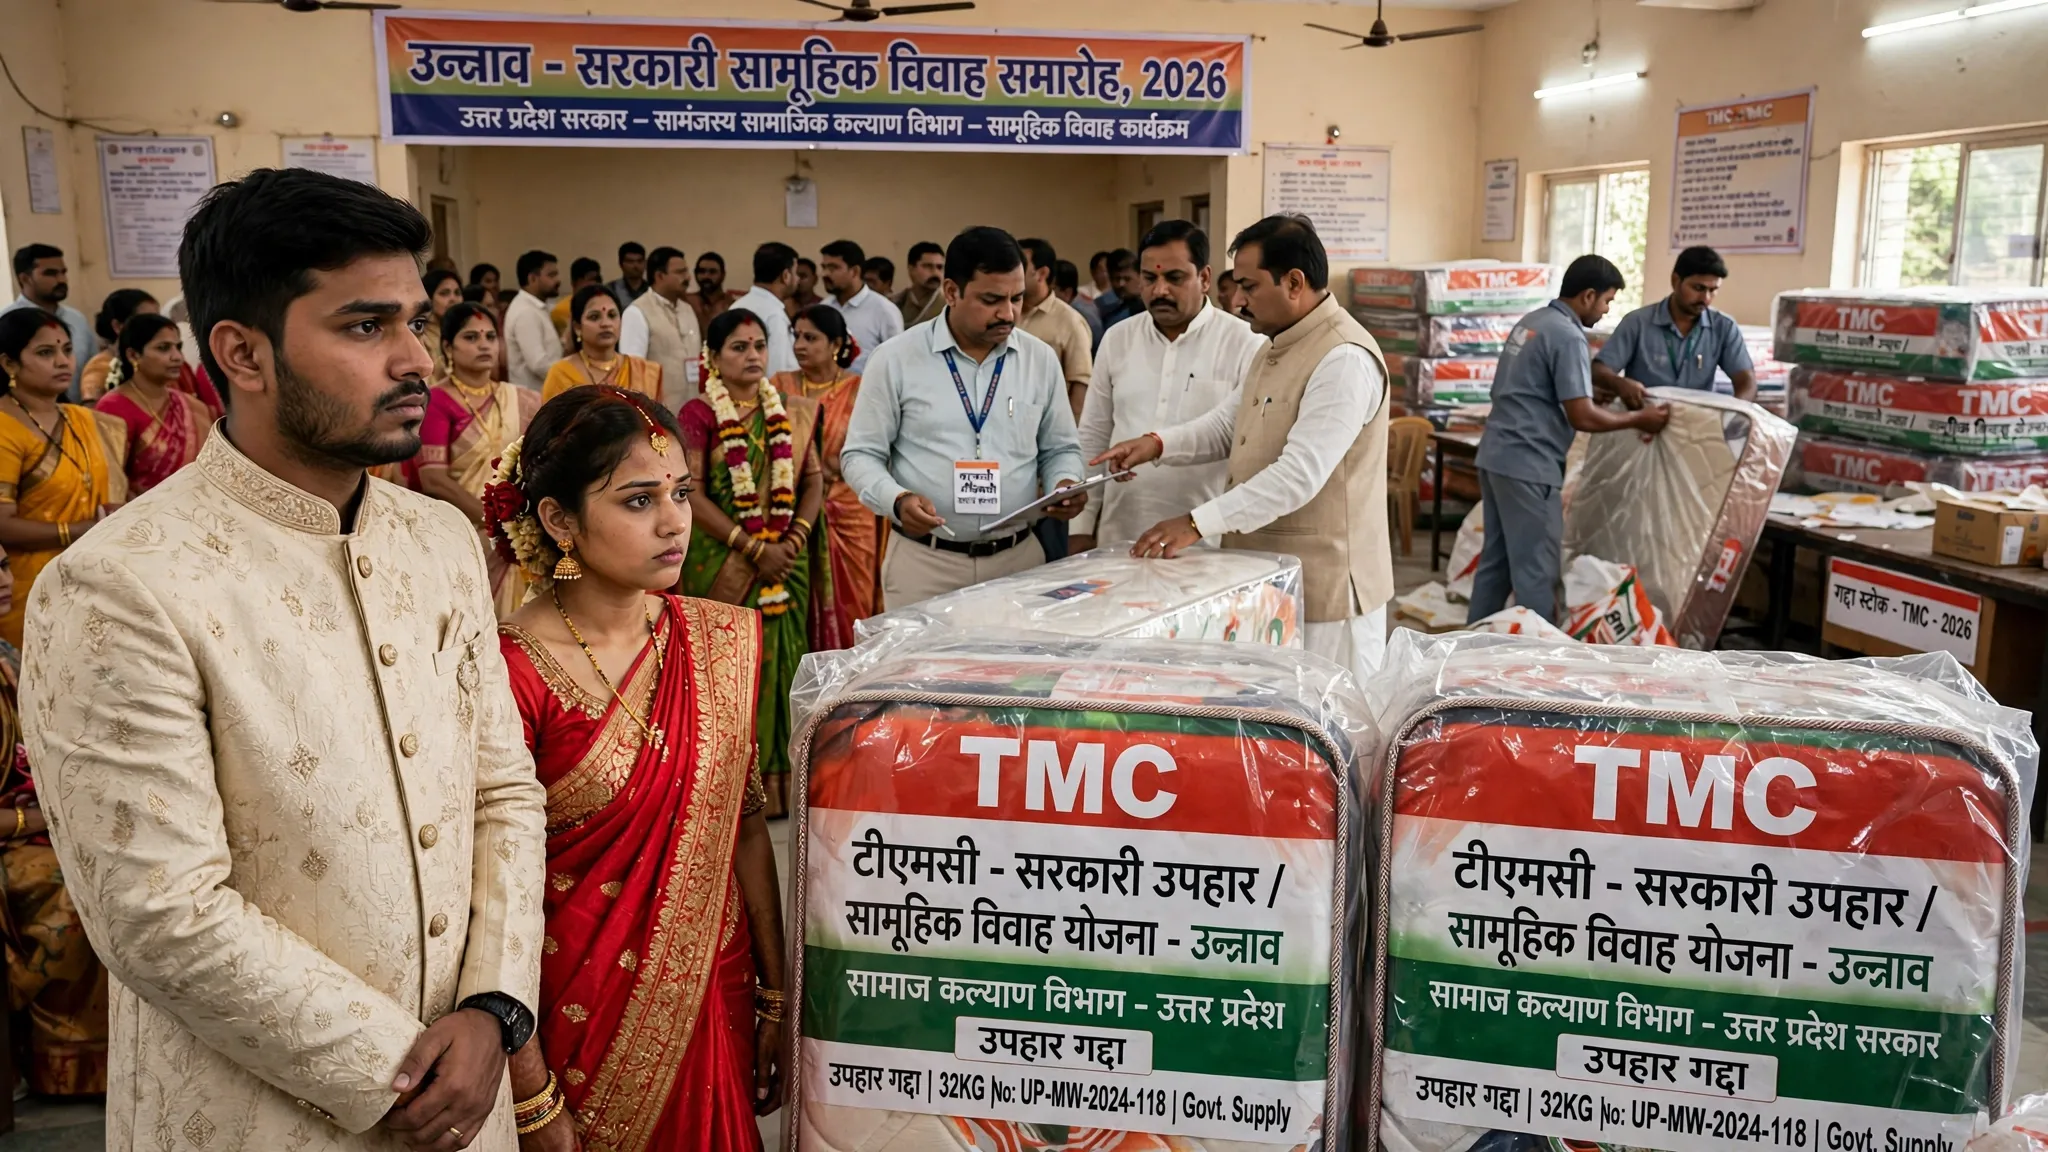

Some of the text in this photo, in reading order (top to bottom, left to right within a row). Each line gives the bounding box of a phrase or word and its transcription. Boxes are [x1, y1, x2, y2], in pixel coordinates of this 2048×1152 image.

[543, 60, 566, 74] -
[573, 33, 720, 91] सरकारी
[726, 35, 880, 107] सामूहिक
[887, 39, 990, 100] विवाह
[995, 43, 1133, 107] समारोह,
[1140, 57, 1229, 101] 2026
[458, 107, 503, 129] उत्तर
[507, 101, 556, 130] प्रदेश
[560, 109, 629, 130] सरकार
[652, 104, 737, 132] सामंजस्य
[740, 106, 829, 133] सामाजिक
[833, 114, 903, 135] कल्याण
[907, 107, 963, 135] विभाग
[986, 110, 1061, 143] सामूहिक
[1064, 111, 1115, 140] विवाह
[1119, 112, 1190, 140] कार्यक्रम
[1476, 271, 1518, 289] TMC
[1836, 307, 1886, 332] TMC
[1465, 363, 1498, 379] TM
[1844, 379, 1895, 407] TMC
[1957, 388, 2032, 415] TMC
[1831, 453, 1883, 481] TMC
[1834, 584, 1857, 609] गद्दा
[1859, 587, 1890, 614] स्टोक
[1901, 601, 1929, 627] TMC
[1941, 613, 1972, 640] 2026
[960, 735, 1178, 819] TMC
[1574, 745, 1817, 836] TMC
[852, 828, 1286, 908] टीएमसी - सरकारी उपहार /
[1452, 839, 1938, 932] टीएमसी - सरकारी उपहार /
[845, 891, 964, 952] सामूहिक
[971, 896, 1055, 954] विवाह
[1063, 903, 1158, 956] योजना
[1167, 938, 1180, 946] -
[1448, 906, 1577, 968] सामूहिक
[1586, 912, 1679, 974] विवाह
[1688, 922, 1793, 979] योजना
[846, 969, 932, 1001] सामाज
[938, 977, 1036, 1011] कल्याण
[1043, 975, 1127, 1018] विभाग
[1156, 993, 1214, 1024] उत्तर
[1221, 988, 1286, 1030] प्रदेश
[1429, 981, 1510, 1015] सामाज
[1516, 990, 1609, 1026] कल्याण
[1616, 991, 1694, 1035] विभाग
[1723, 1012, 1779, 1044] उत्तर
[1785, 1009, 1848, 1050] प्रदेश
[1855, 1025, 1941, 1059] सरकार
[978, 1026, 1127, 1071] उपहार गद्दा
[1583, 1045, 1749, 1096] उपहार गद्दा
[828, 1062, 884, 1094] उपहार
[888, 1068, 921, 1100] गद्दा
[939, 1071, 984, 1101] 32KG
[1021, 1078, 1166, 1116] UP-MW-2024-118
[1183, 1091, 1226, 1121] Govt.
[1232, 1095, 1291, 1133] Supply
[1415, 1076, 1478, 1109] उपहार
[1483, 1085, 1520, 1117] गद्दा
[1540, 1090, 1593, 1122] 32KG
[1632, 1100, 1806, 1147] UP-MW-2024-118
[1827, 1122, 1877, 1152] Govt.
